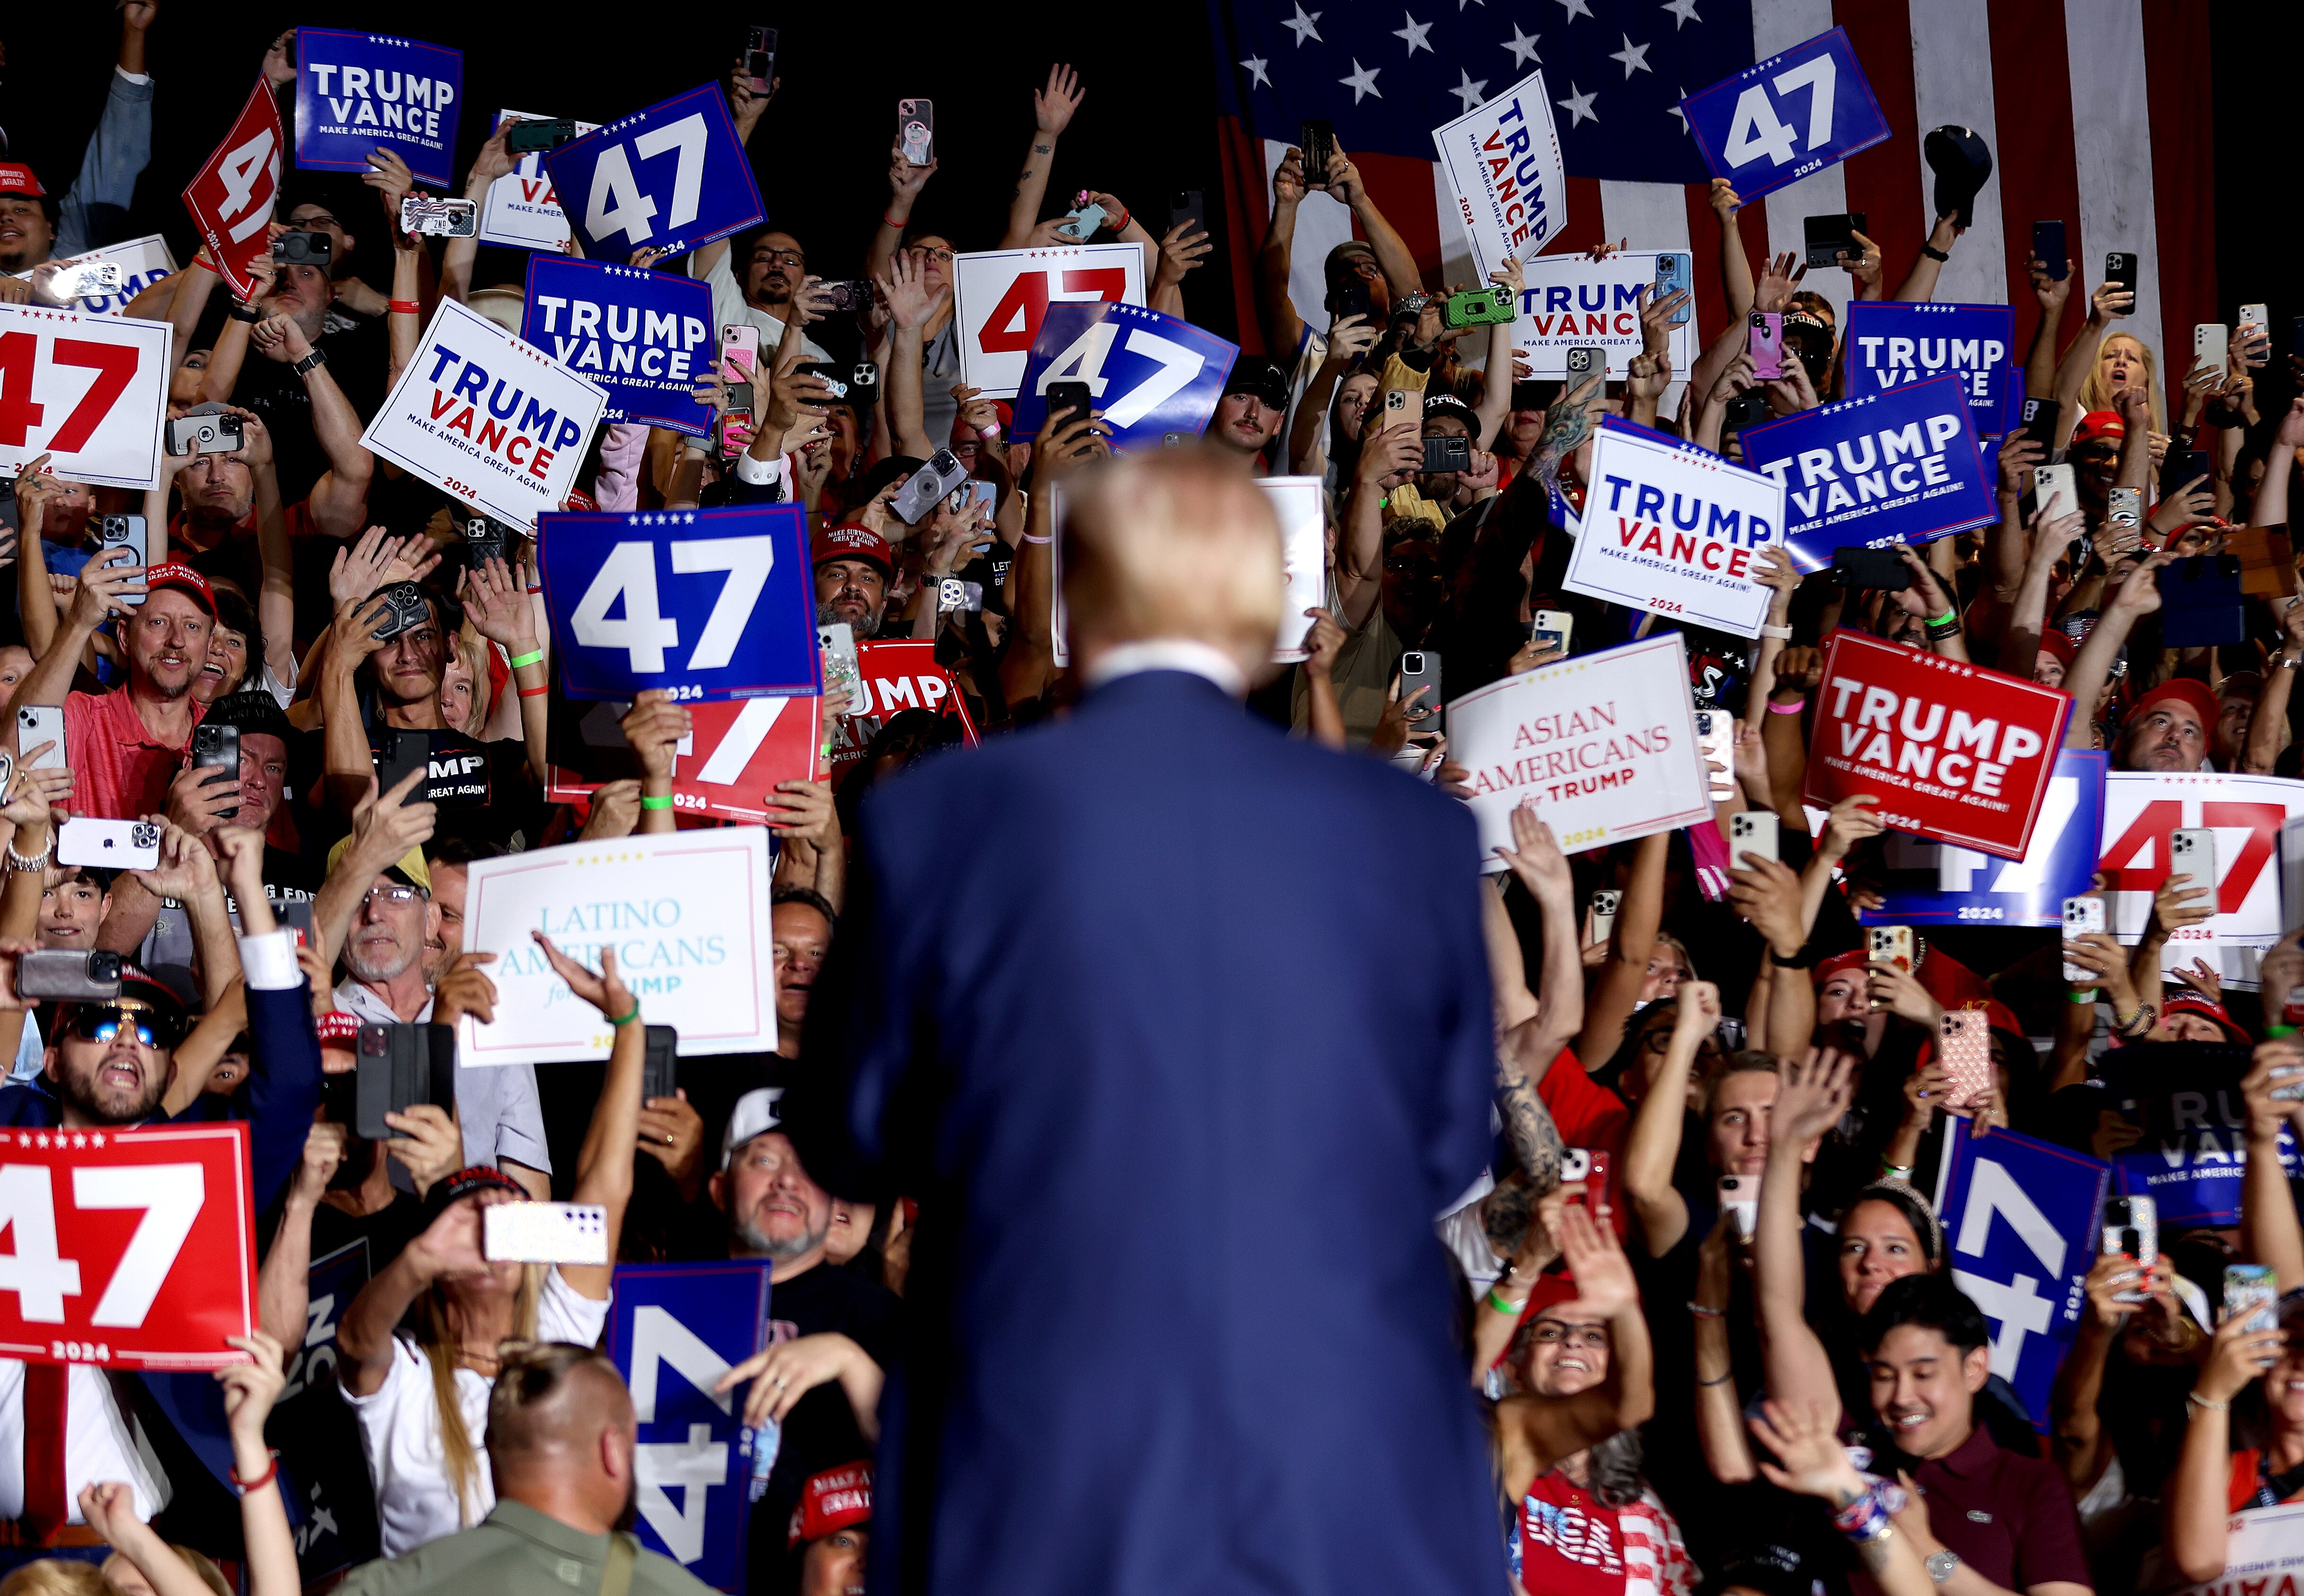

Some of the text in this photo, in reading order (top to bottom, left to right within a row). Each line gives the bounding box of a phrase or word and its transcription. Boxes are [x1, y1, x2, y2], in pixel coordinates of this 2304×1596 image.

[310, 63, 454, 111] TRUMP
[329, 97, 440, 137] VANCE
[1724, 52, 1836, 169] 47
[319, 125, 443, 150] MAKE AMERICA GREAT AGAIN!
[218, 127, 280, 244] 47
[585, 113, 707, 245] 47
[1498, 97, 1548, 242] TRUMP
[1794, 158, 1822, 178] 2024
[1469, 133, 1514, 259] MAKE AMERICA GREAT AGAIN
[1482, 129, 1529, 248] VANCE
[507, 203, 533, 213] MAKE
[1459, 197, 1474, 225] 2024
[207, 229, 220, 251] 2024
[556, 240, 571, 249] 20
[1520, 284, 1644, 315] TRUM
[538, 296, 706, 351] TRUMP
[1532, 313, 1634, 336] VANC
[554, 336, 691, 380] VANCE
[1858, 337, 2005, 370] TRUMP
[577, 372, 694, 393] MERICA GREAT AGAIN!
[1036, 322, 1205, 429] 47
[429, 343, 581, 453] TRUMP
[601, 407, 624, 419] 024
[1425, 395, 1468, 407] Trum
[431, 388, 554, 480] VANCE
[1760, 414, 1961, 487] TRUMP
[407, 413, 550, 497] MAKE AMERICA GREAT AGAIN!
[444, 477, 477, 500] 2024
[1790, 454, 1951, 518] VANCE
[1605, 474, 1771, 549] TRUMP
[1789, 482, 1965, 535] MAKE AMERICA GREAT AGAIN!
[828, 529, 879, 544] MAKE SURVEYING
[856, 537, 874, 548] AGAIN
[1618, 517, 1750, 578] VANCE
[148, 565, 205, 586] AKE AMERICA
[178, 571, 203, 588] AGAIN
[993, 561, 1011, 572] LET'
[1600, 547, 1751, 593] MAKE AMERICA GREAT AGAIN!
[571, 535, 774, 673] 47
[1649, 597, 1683, 614] 2024
[668, 684, 704, 700] 024
[850, 676, 947, 716] UMP
[1513, 702, 1617, 751] ASIAN
[1831, 676, 2043, 766] TRUMP
[1471, 726, 1672, 798] AMERICANS
[1841, 723, 2007, 797] VANCE
[457, 785, 486, 795] AGAIN!
[673, 793, 706, 810] 024
[1549, 769, 1636, 803] TRUMP
[1824, 756, 2010, 813] MAKE AMERICA GREAT AGAIN!
[1563, 827, 1606, 847] 2024
[1876, 810, 1921, 831] 2024
[2099, 800, 2286, 914] 47
[541, 897, 681, 935] LATINO
[1958, 906, 2005, 921] 2024
[2170, 929, 2212, 939] 2024
[624, 976, 682, 994] UMP
[593, 1035, 616, 1049] 20
[2146, 1166, 2246, 1186] MAKE AMERIC
[0, 1162, 205, 1328] 47
[1951, 1157, 2067, 1384] 47
[2063, 1274, 2085, 1322] 2024
[52, 1342, 110, 1362] 2024
[630, 1305, 732, 1566] 47
[739, 1425, 754, 1457] 20
